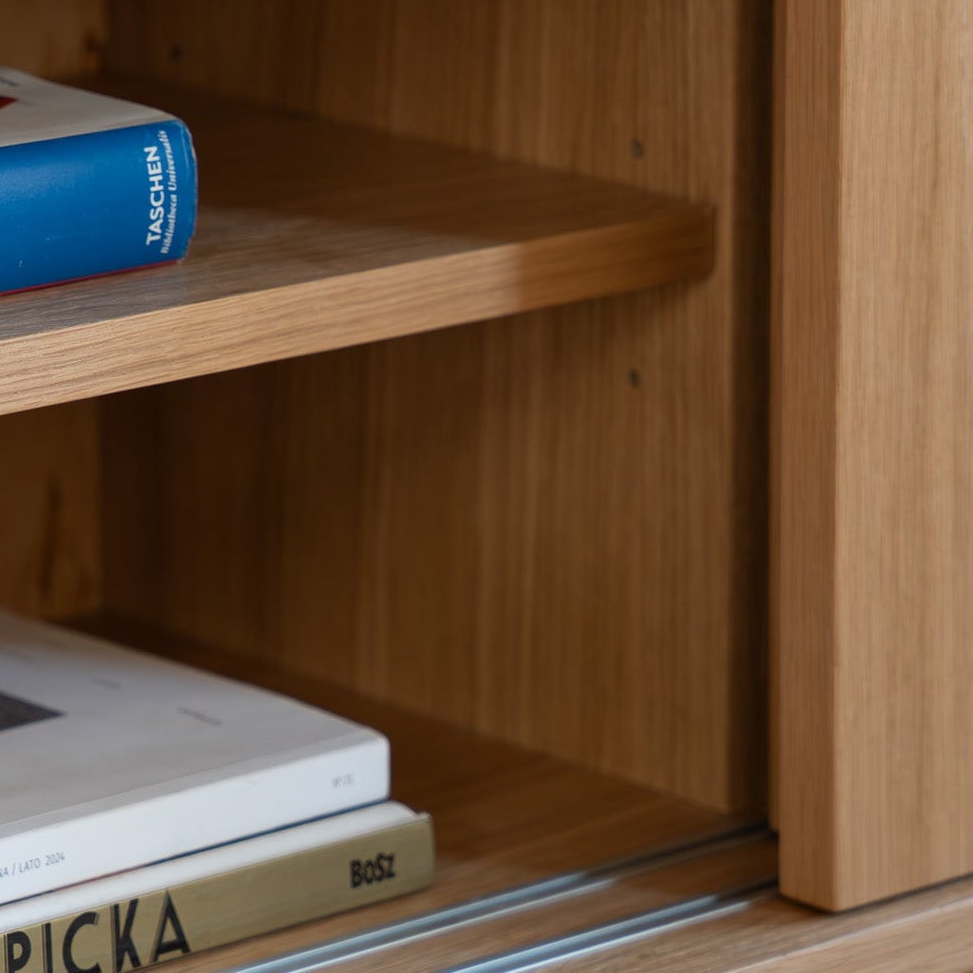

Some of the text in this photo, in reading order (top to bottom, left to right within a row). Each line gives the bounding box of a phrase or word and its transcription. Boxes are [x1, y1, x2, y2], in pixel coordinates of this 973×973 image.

[157, 130, 177, 191] Universalis
[143, 145, 165, 246] TASCHEN
[19, 858, 41, 873] LATO
